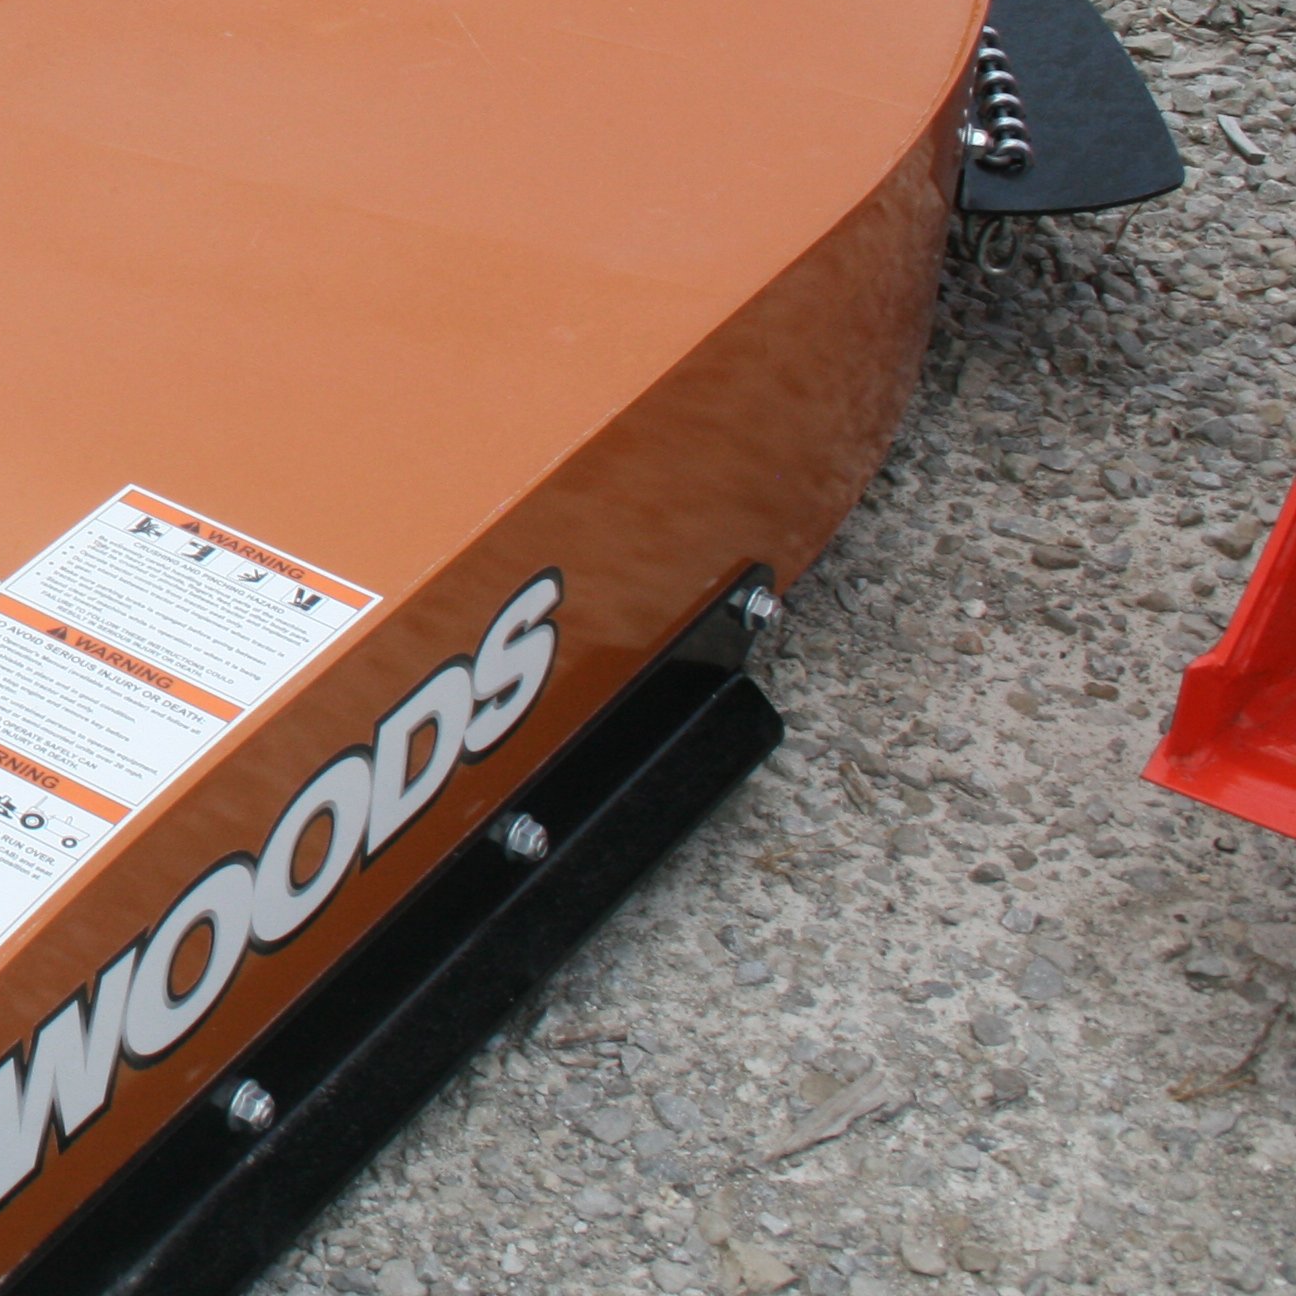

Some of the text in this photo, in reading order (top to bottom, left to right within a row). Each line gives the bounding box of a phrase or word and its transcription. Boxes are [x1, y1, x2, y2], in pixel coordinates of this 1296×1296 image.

[204, 530, 307, 580] WARNING
[6, 625, 45, 646] AVOID
[42, 642, 98, 671] SERIOUS
[95, 668, 142, 693] INJURY
[139, 689, 162, 703] OR
[160, 699, 207, 724] DEATH:
[72, 636, 175, 689] WARNING
[0, 727, 34, 746] INJURY
[31, 743, 48, 754] OR
[1, 719, 44, 743] OPERATE
[42, 739, 78, 760] SAFELY
[75, 756, 98, 769] CAN
[0, 833, 26, 850] RUN
